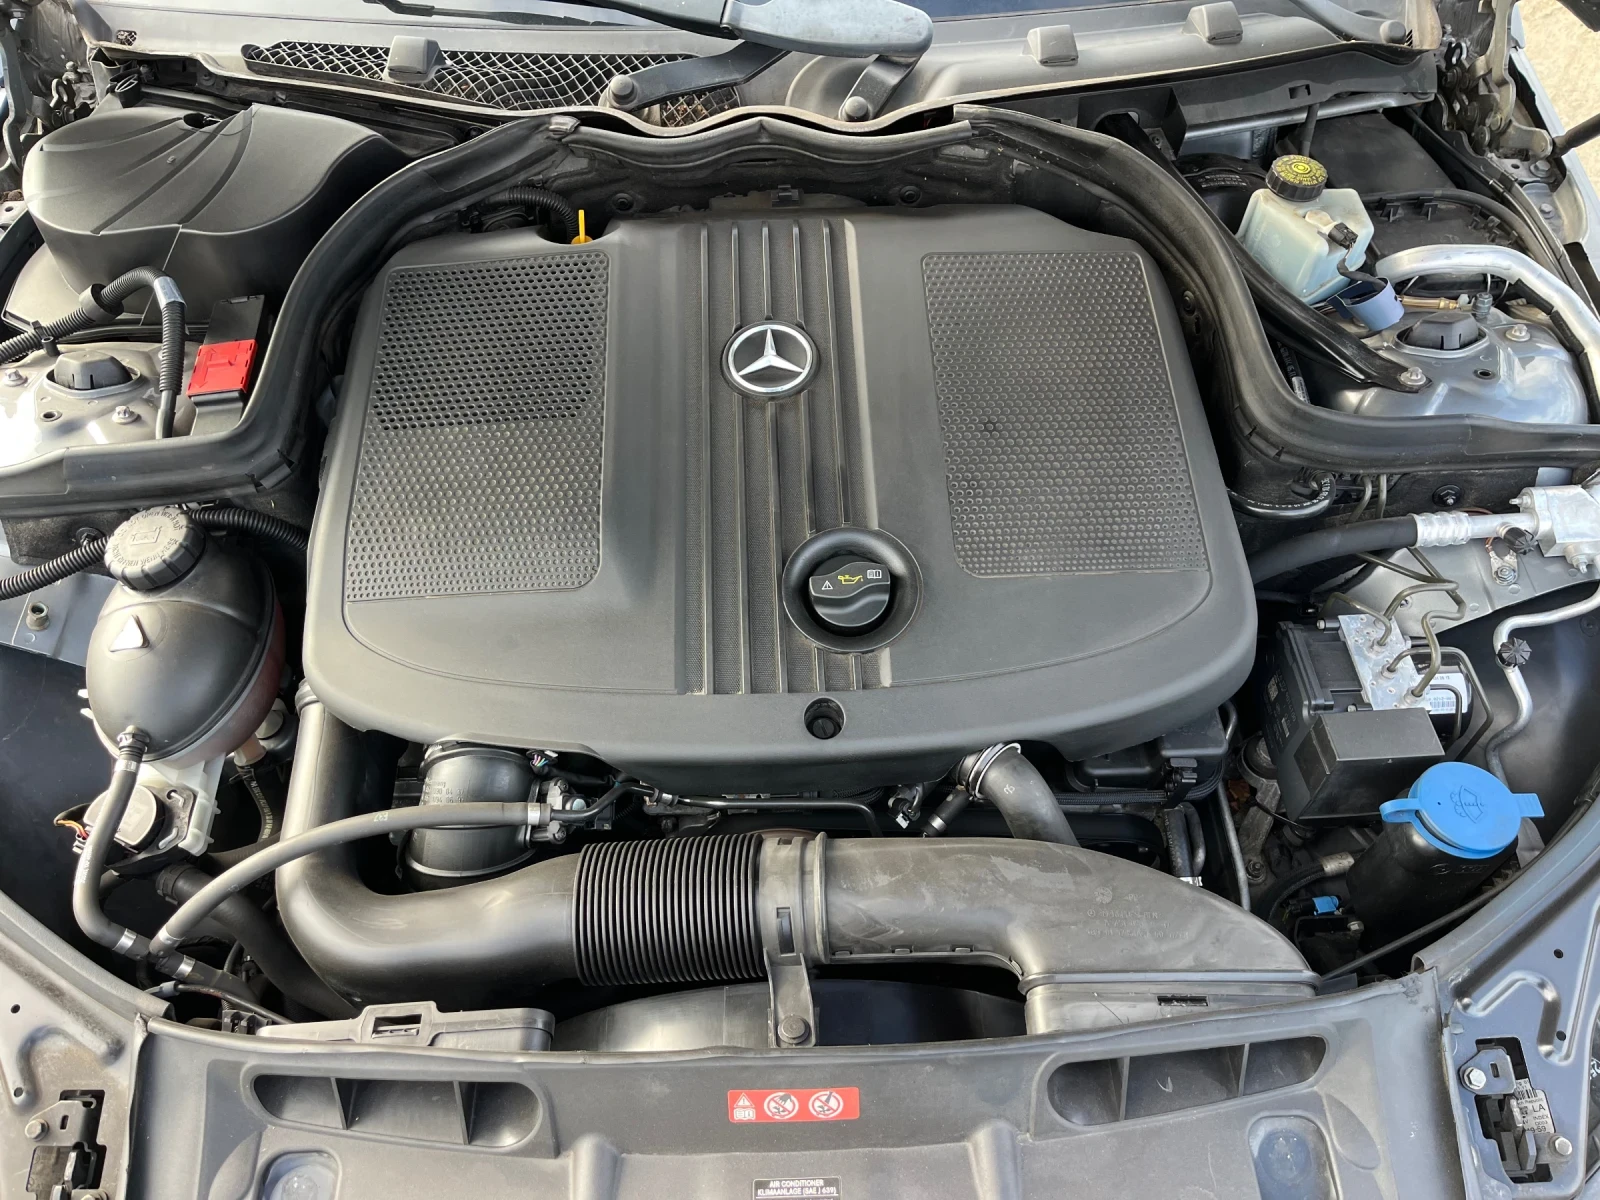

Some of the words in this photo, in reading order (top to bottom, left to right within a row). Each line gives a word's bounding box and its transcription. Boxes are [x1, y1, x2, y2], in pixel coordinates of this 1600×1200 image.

[1532, 1104, 1546, 1112] LA
[781, 1179, 824, 1187] CONDITIONER
[757, 1188, 802, 1196] KLIMAANLAGE
